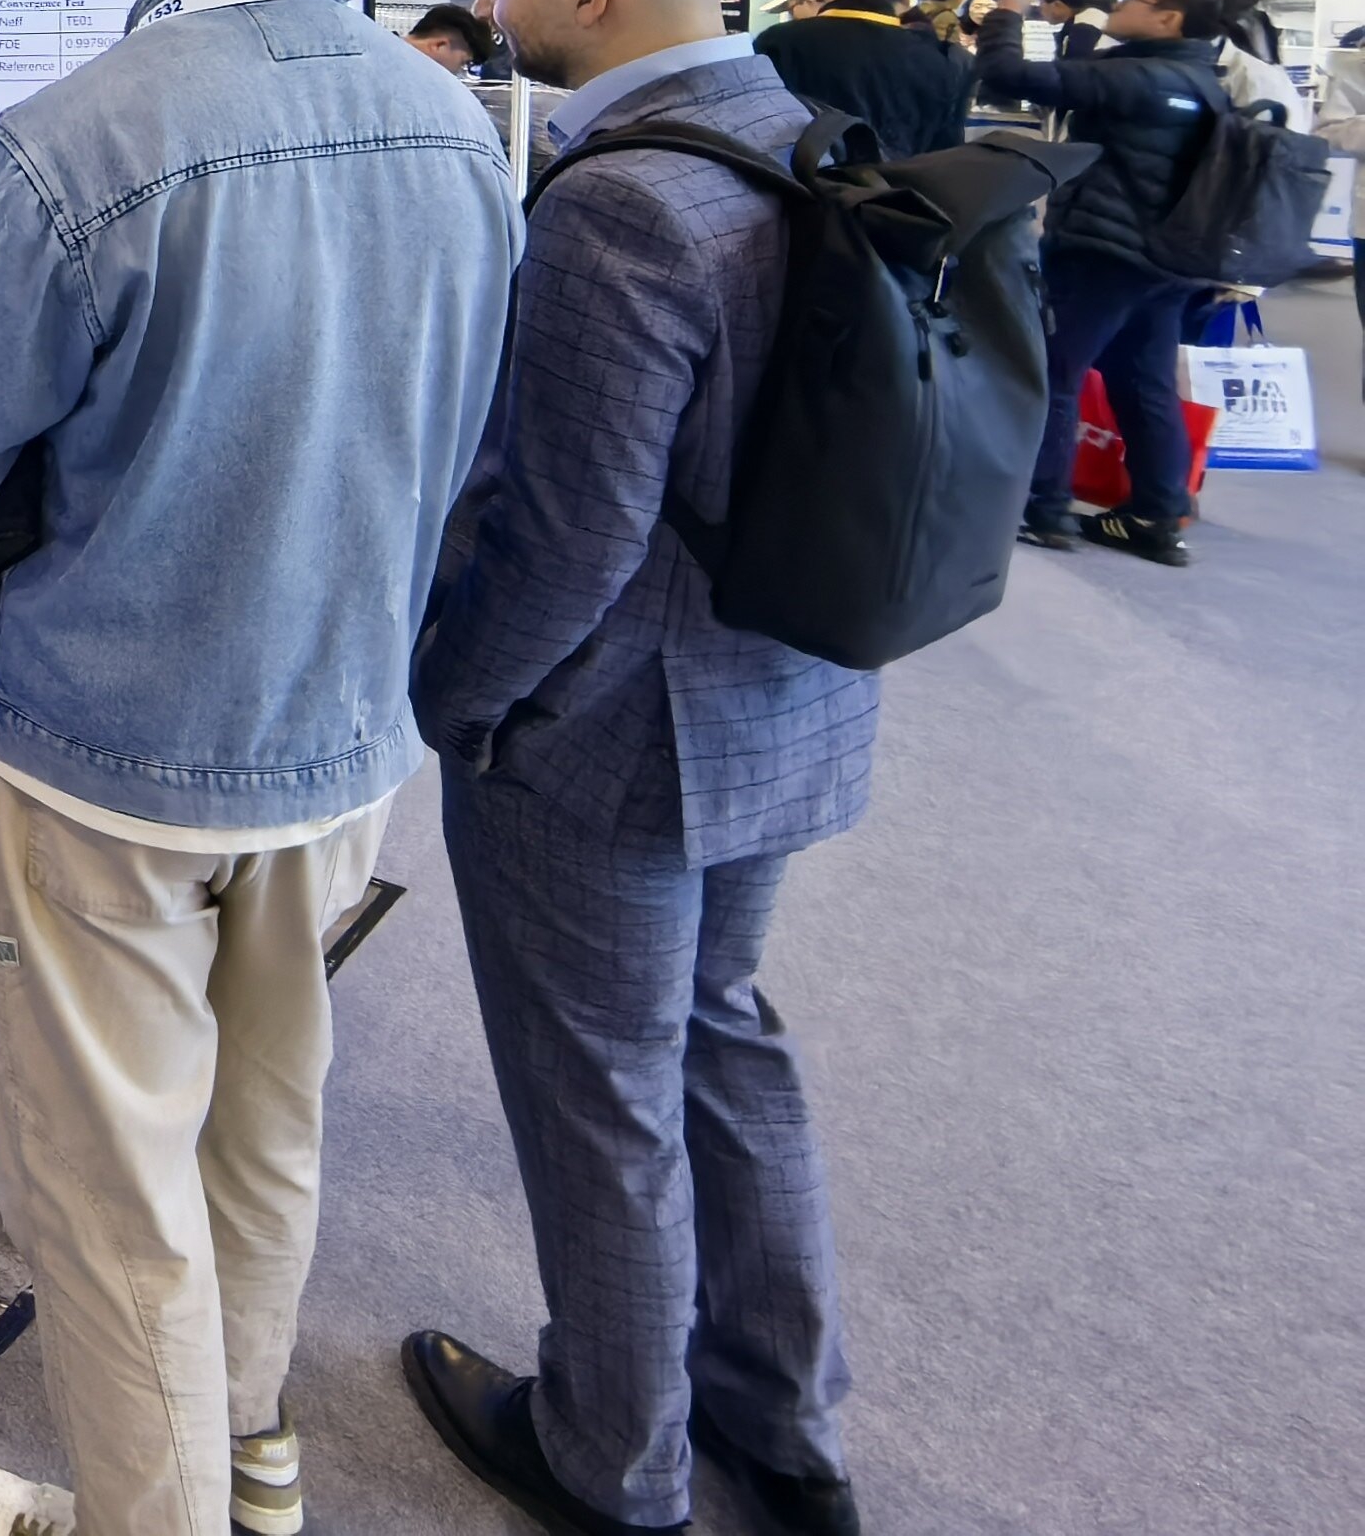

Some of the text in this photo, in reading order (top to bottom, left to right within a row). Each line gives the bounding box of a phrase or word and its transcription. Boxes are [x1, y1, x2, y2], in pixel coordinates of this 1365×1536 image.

[0, 0, 61, 8] Convergence
[66, 15, 93, 26] TE01
[65, 59, 86, 71] 0.9
